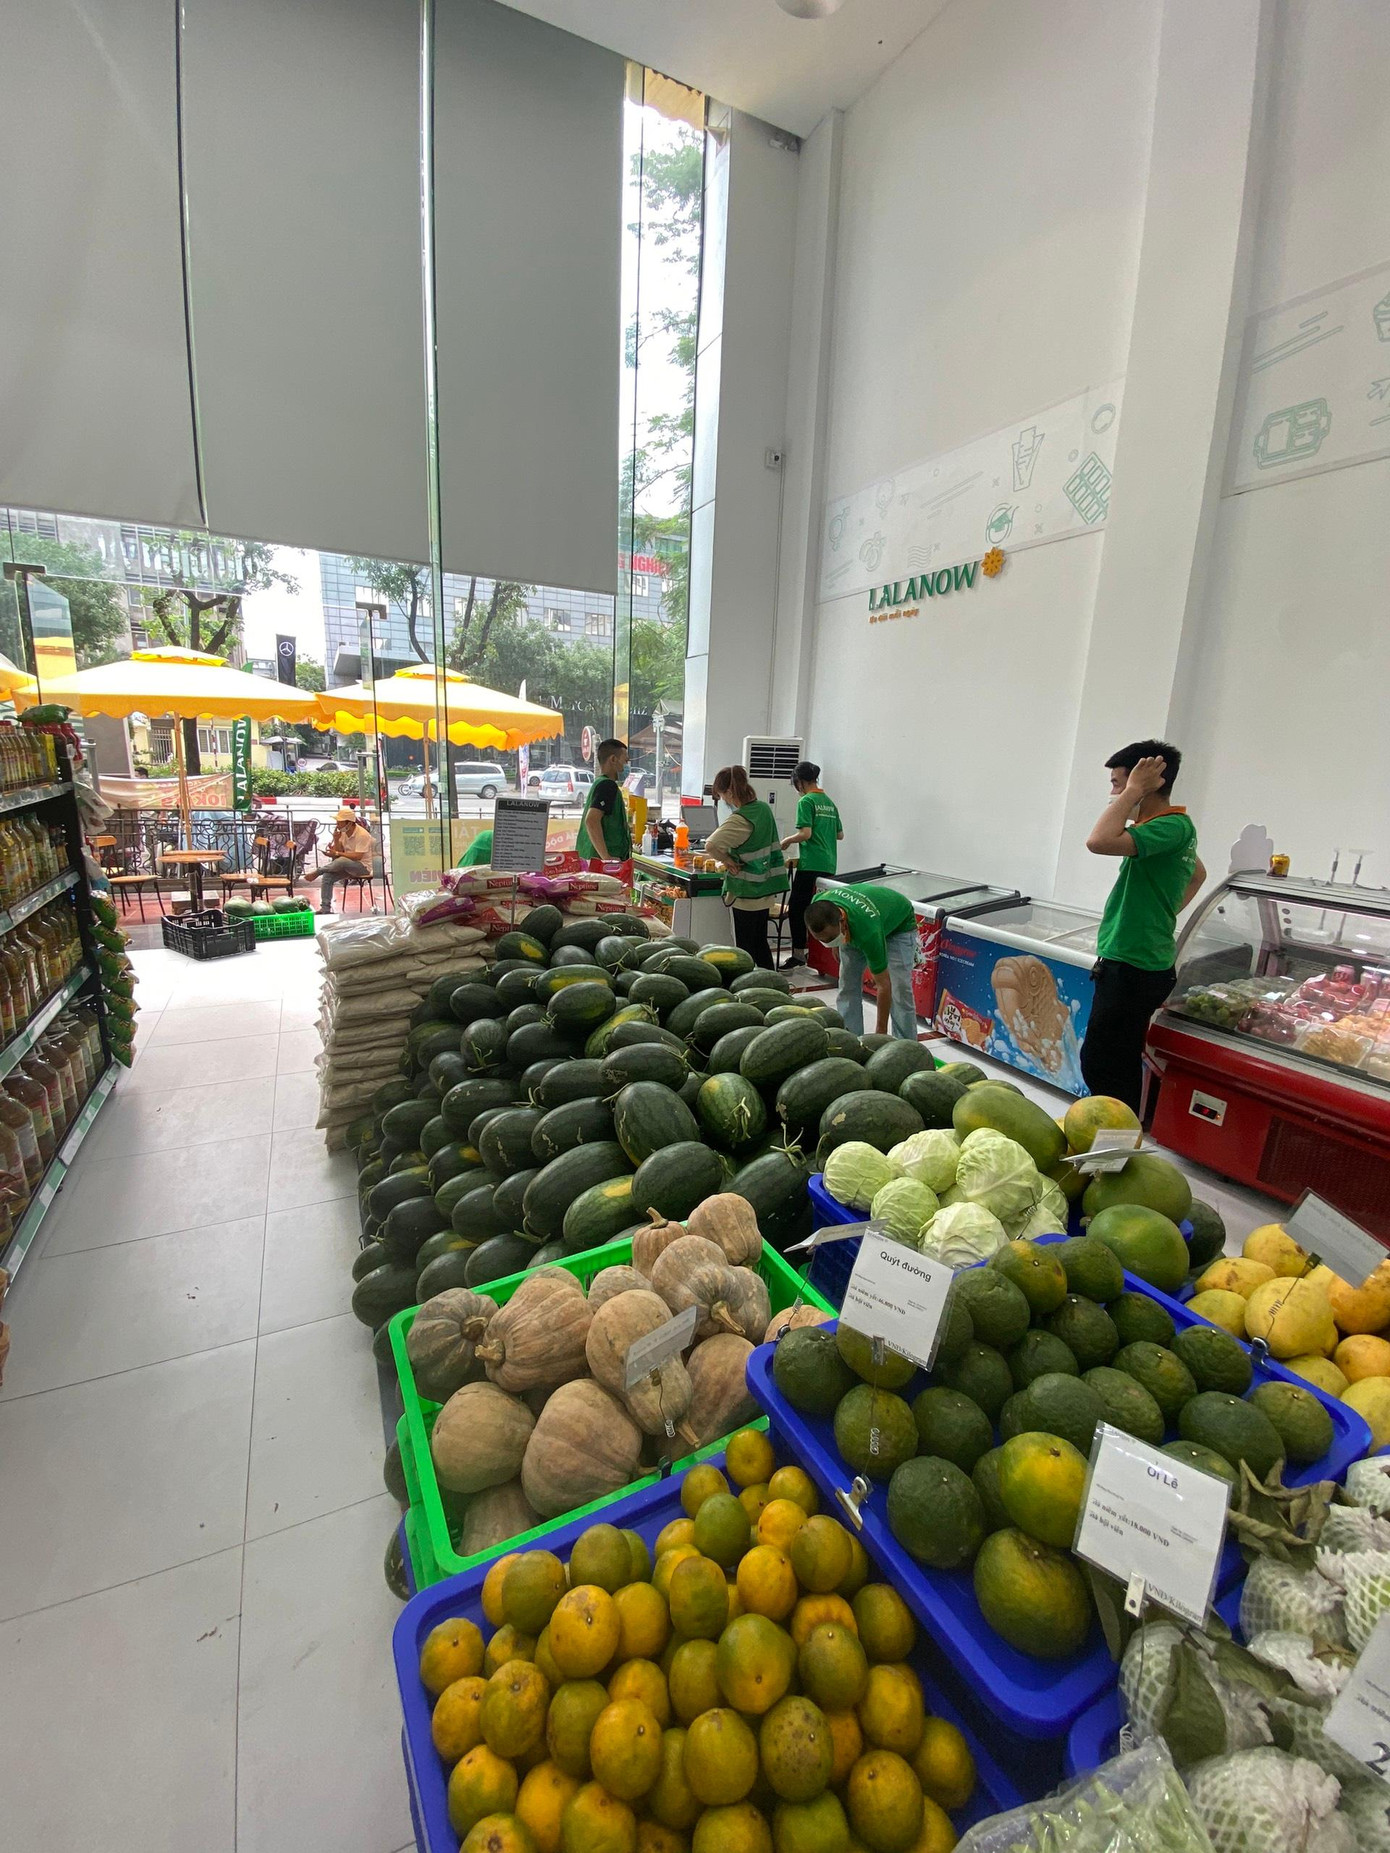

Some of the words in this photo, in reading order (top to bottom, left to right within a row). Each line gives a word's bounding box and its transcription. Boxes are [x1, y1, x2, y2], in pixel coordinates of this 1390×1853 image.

[868, 561, 979, 611] LALANOW
[833, 889, 876, 918] LALANOW
[491, 924, 510, 932] Nept
[880, 1251, 900, 1266] Quýt
[1163, 1474, 1179, 1489] Lê
